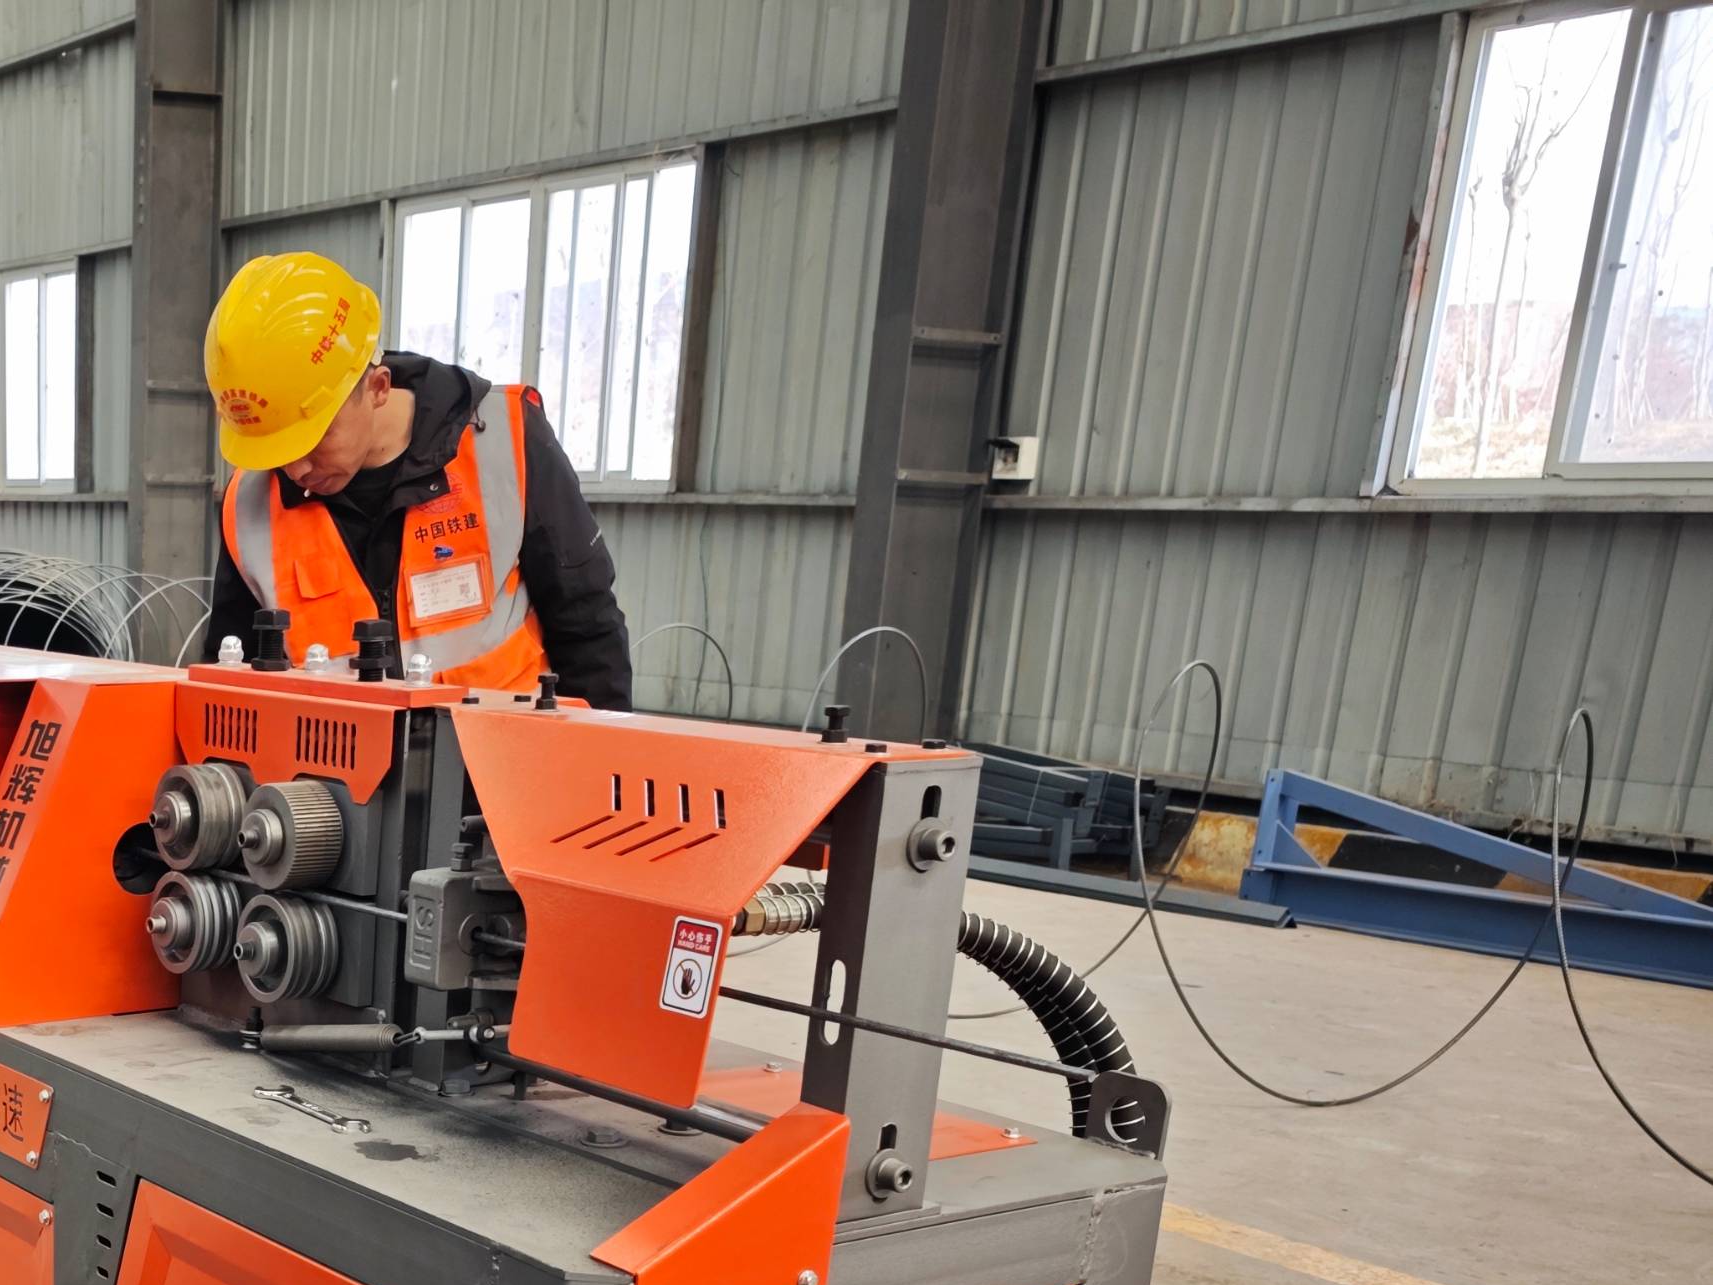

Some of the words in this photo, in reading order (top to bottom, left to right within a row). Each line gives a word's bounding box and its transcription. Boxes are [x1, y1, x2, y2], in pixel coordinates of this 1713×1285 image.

[414, 512, 480, 544] 中国铁建
[679, 928, 713, 945] 小心伤手
[695, 943, 711, 953] CARE
